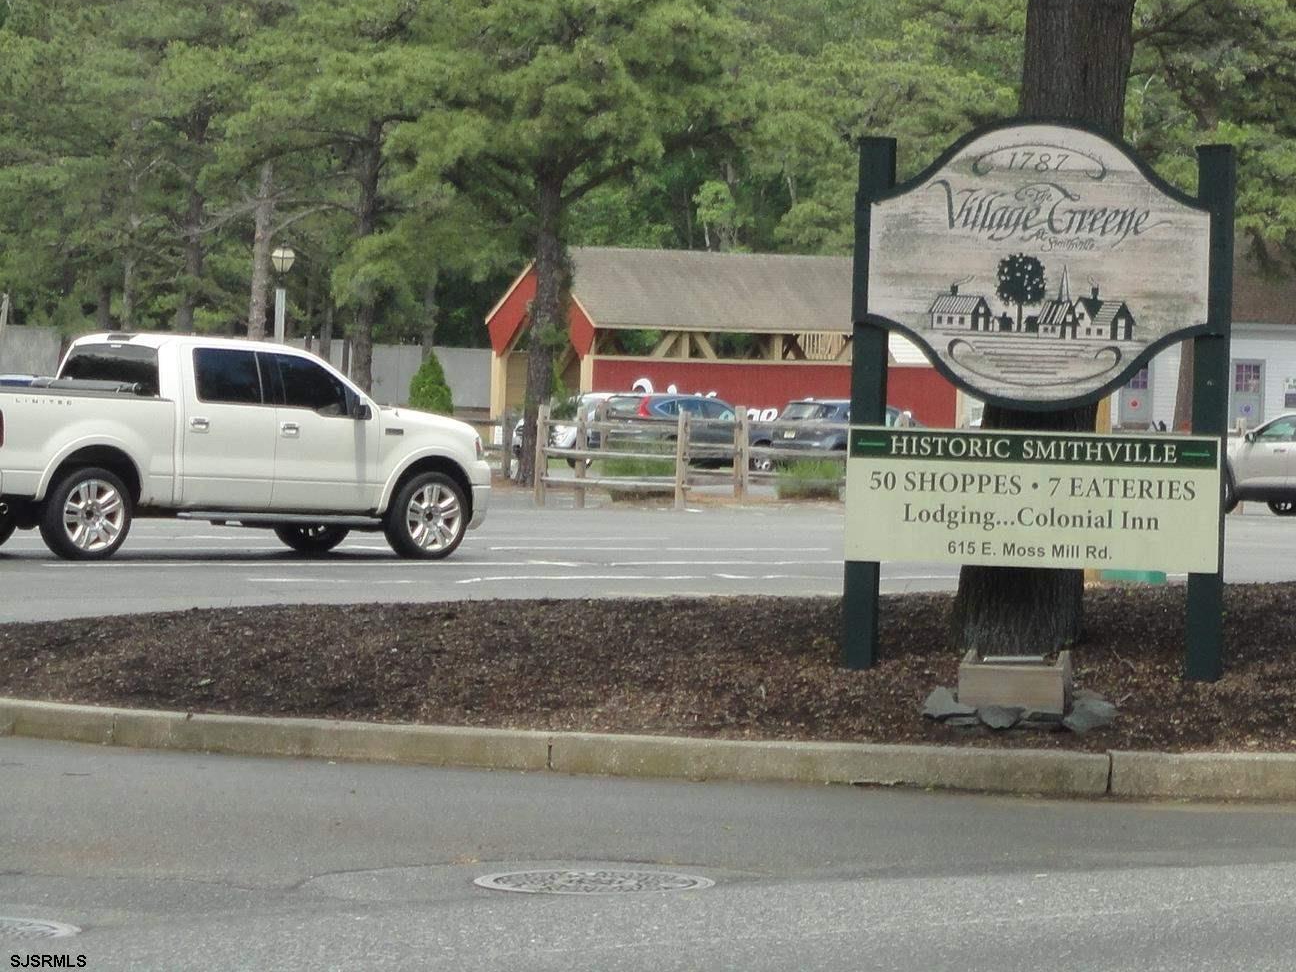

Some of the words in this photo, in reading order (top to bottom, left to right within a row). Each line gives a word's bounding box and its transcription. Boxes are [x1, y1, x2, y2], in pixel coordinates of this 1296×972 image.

[1007, 151, 1070, 173] 1787
[926, 179, 1046, 241] Village
[1015, 182, 1173, 249] Greene
[889, 434, 1011, 459] HISTORIC
[1022, 439, 1178, 464] SMITHVILLE
[868, 470, 897, 492] 50
[903, 471, 1023, 496] SHOPPES
[1048, 477, 1061, 498] 7
[1069, 476, 1197, 502] EATERIES
[1121, 511, 1160, 531] Inn
[947, 540, 977, 556] 615
[981, 541, 997, 557] E.
[1002, 542, 1046, 559] Moss
[1051, 543, 1080, 560] Mill
[1085, 544, 1113, 561] Rd.
